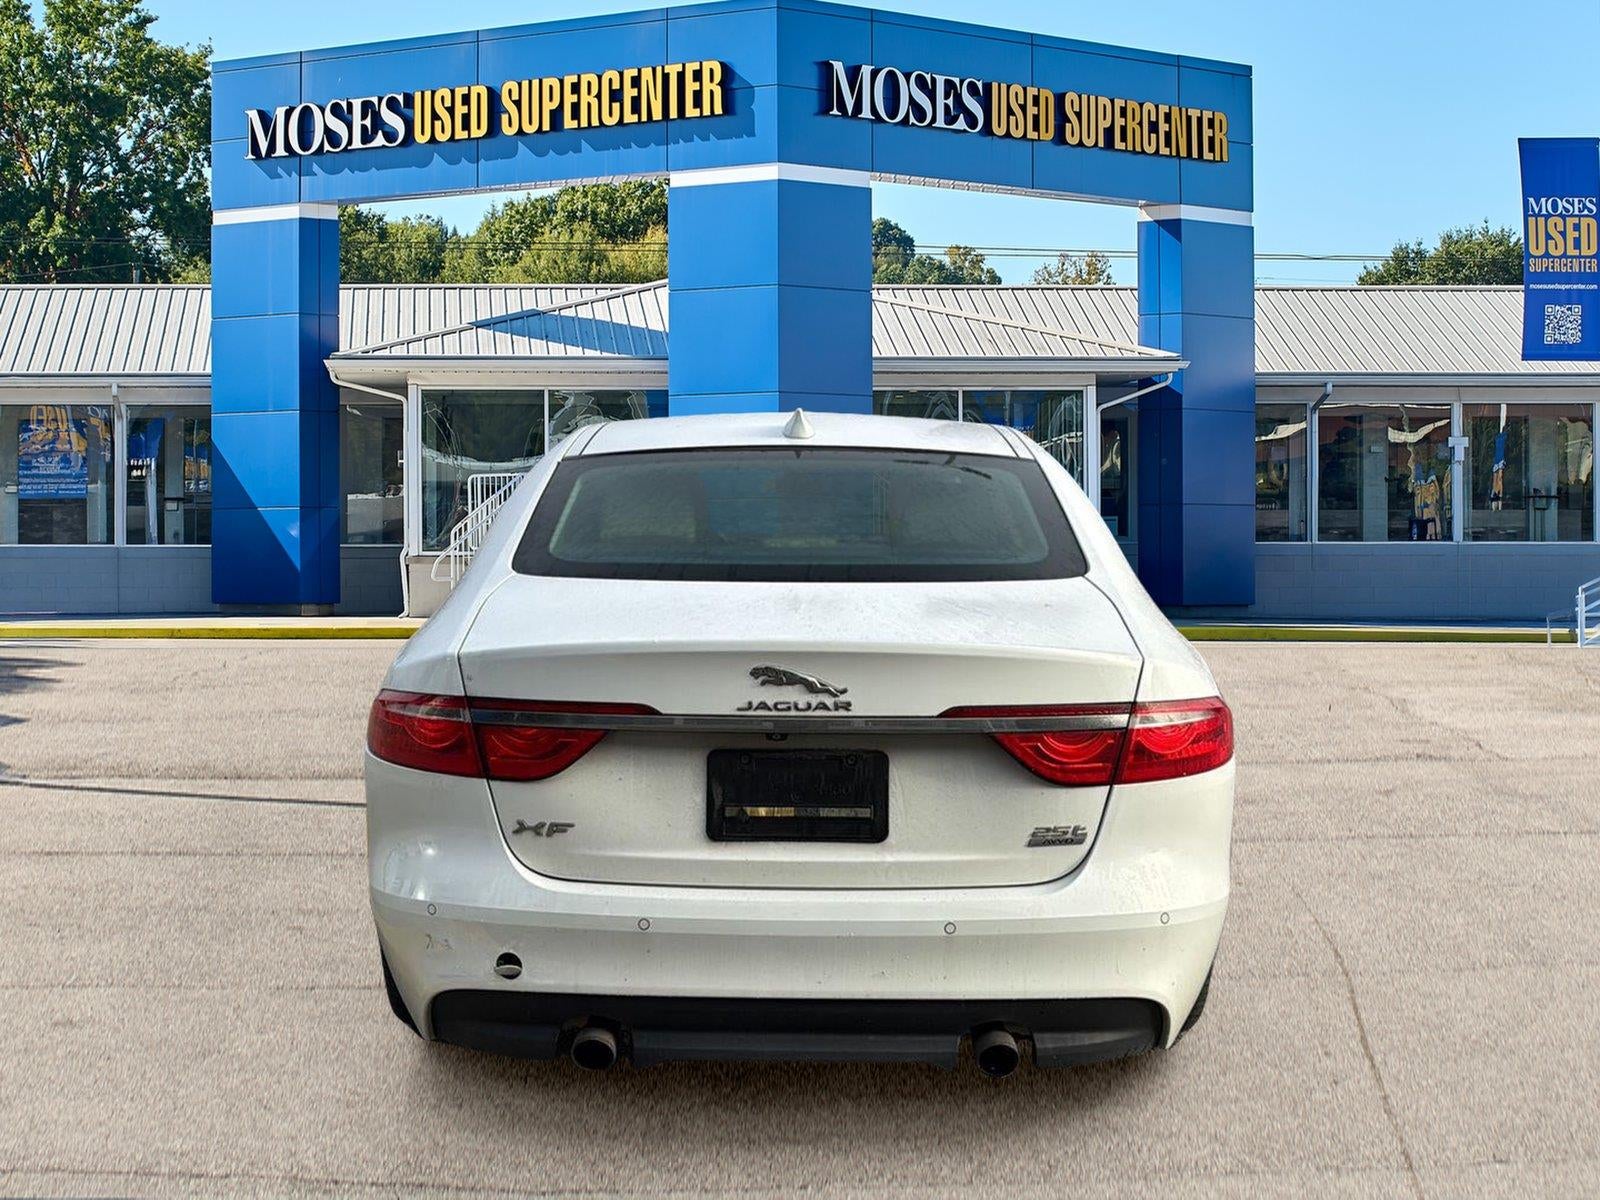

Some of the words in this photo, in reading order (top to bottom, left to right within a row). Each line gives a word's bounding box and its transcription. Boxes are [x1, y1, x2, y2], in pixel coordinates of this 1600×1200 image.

[244, 92, 406, 160] MOSES
[413, 85, 489, 145] USED
[501, 59, 723, 136] SUPERCENTER
[828, 60, 984, 133] MOSES
[991, 81, 1055, 141] USED
[1064, 91, 1229, 162] SUPERCENTER
[1527, 197, 1597, 215] MOSES
[1528, 216, 1598, 256] USED
[1529, 258, 1598, 272] SUPERCENTER
[736, 701, 852, 712] JAGUAR
[512, 819, 575, 837] XF
